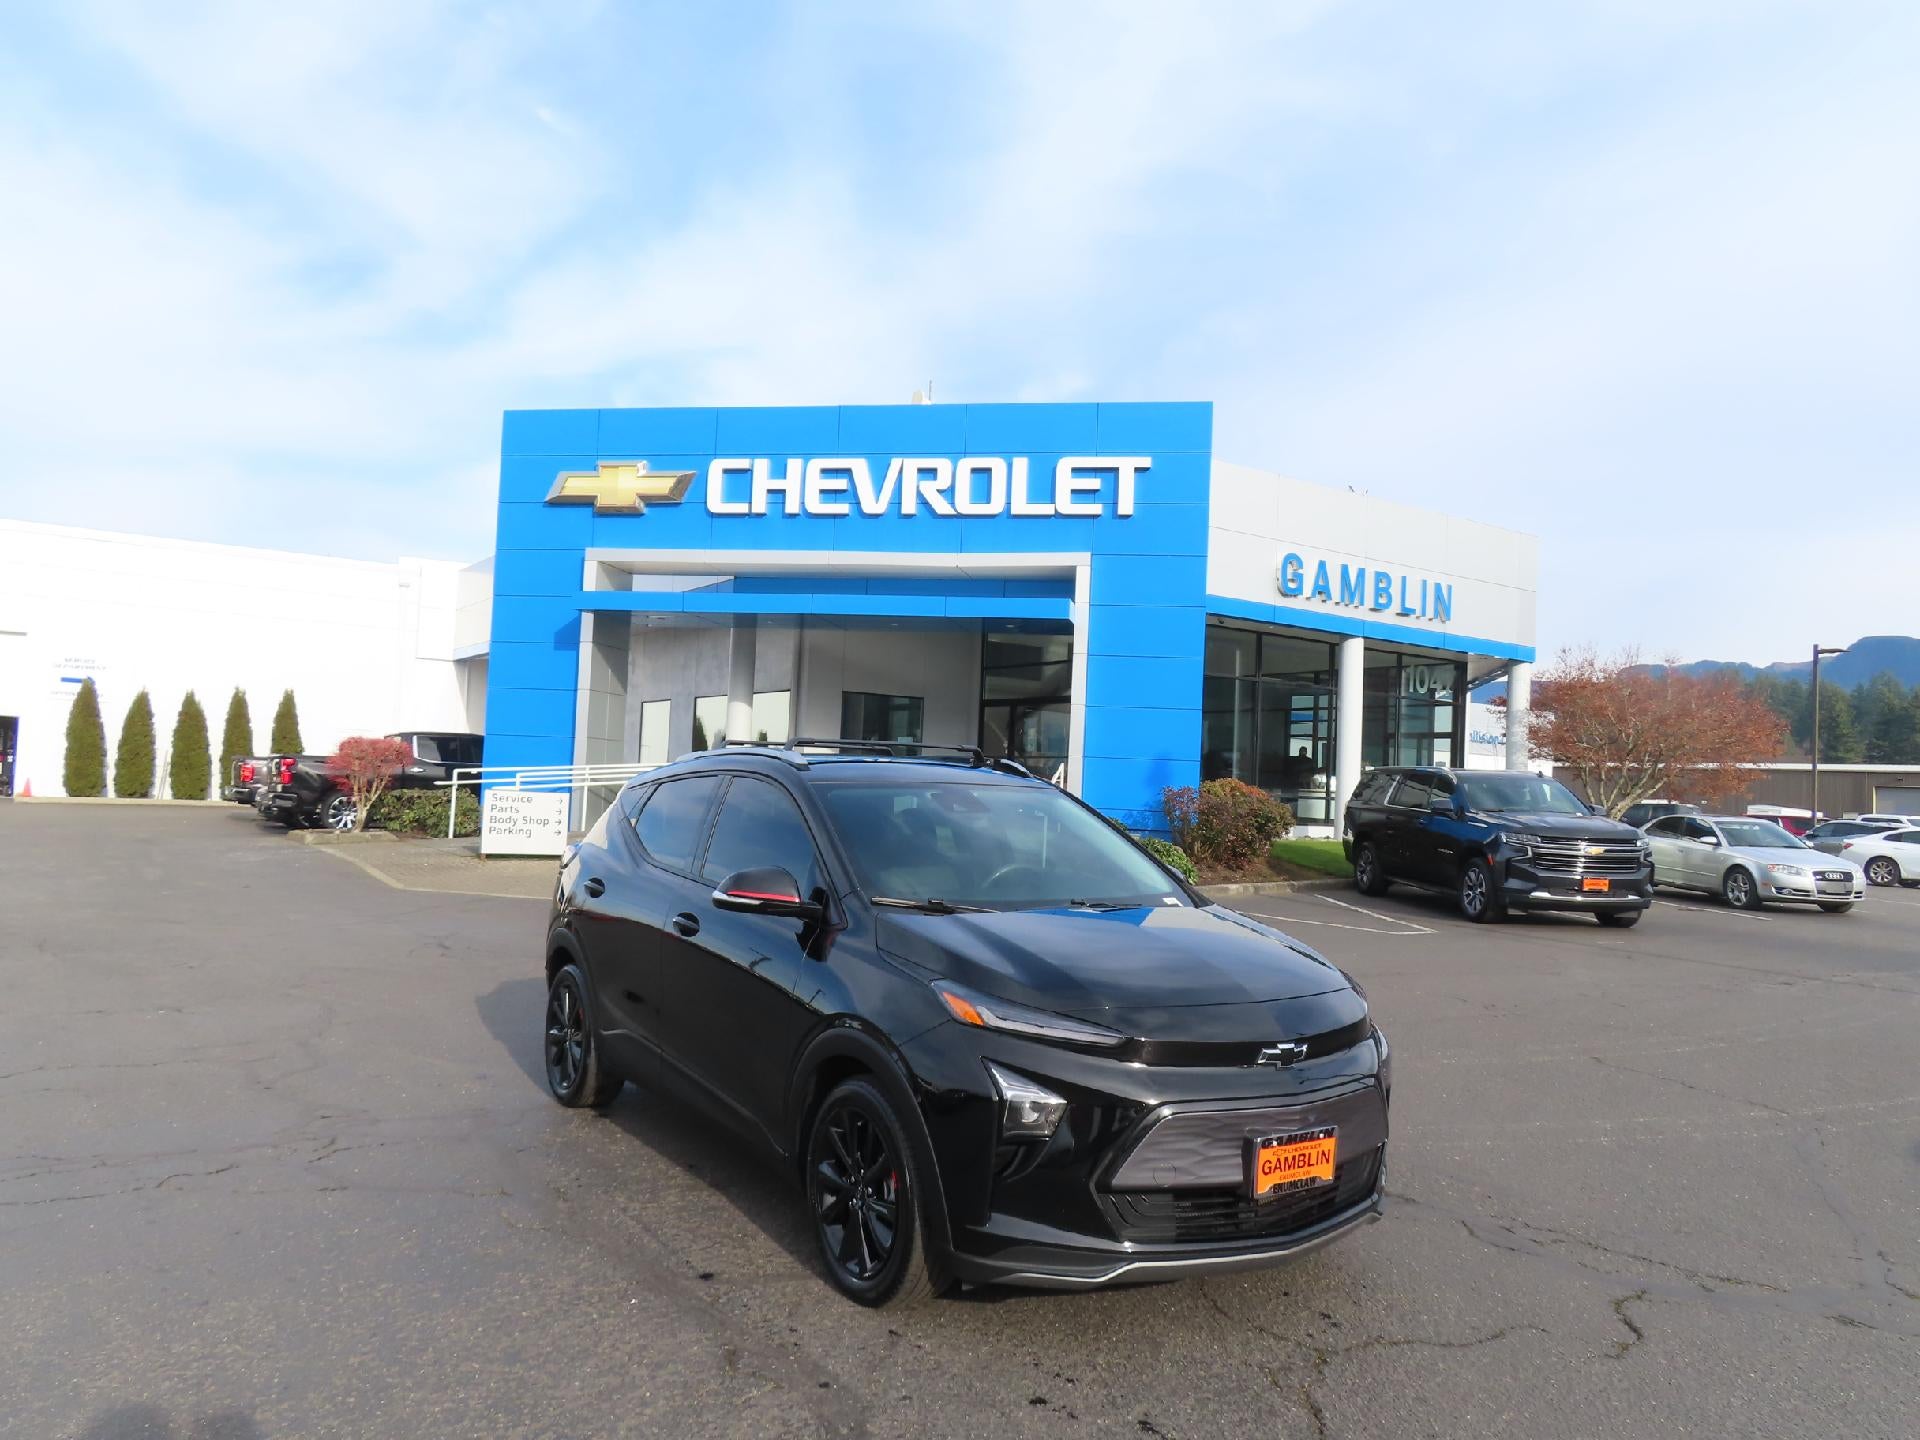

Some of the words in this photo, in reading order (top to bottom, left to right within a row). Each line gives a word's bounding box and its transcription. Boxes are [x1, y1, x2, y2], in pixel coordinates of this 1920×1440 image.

[707, 457, 1152, 516] CHEVROLET
[1278, 552, 1453, 622] GAMBLIN
[492, 793, 533, 804] Service
[491, 804, 520, 814] Parts
[490, 816, 518, 826] Body
[523, 816, 550, 828] Shop
[489, 826, 532, 838] Parking
[1262, 1149, 1331, 1176] GAMBLIN
